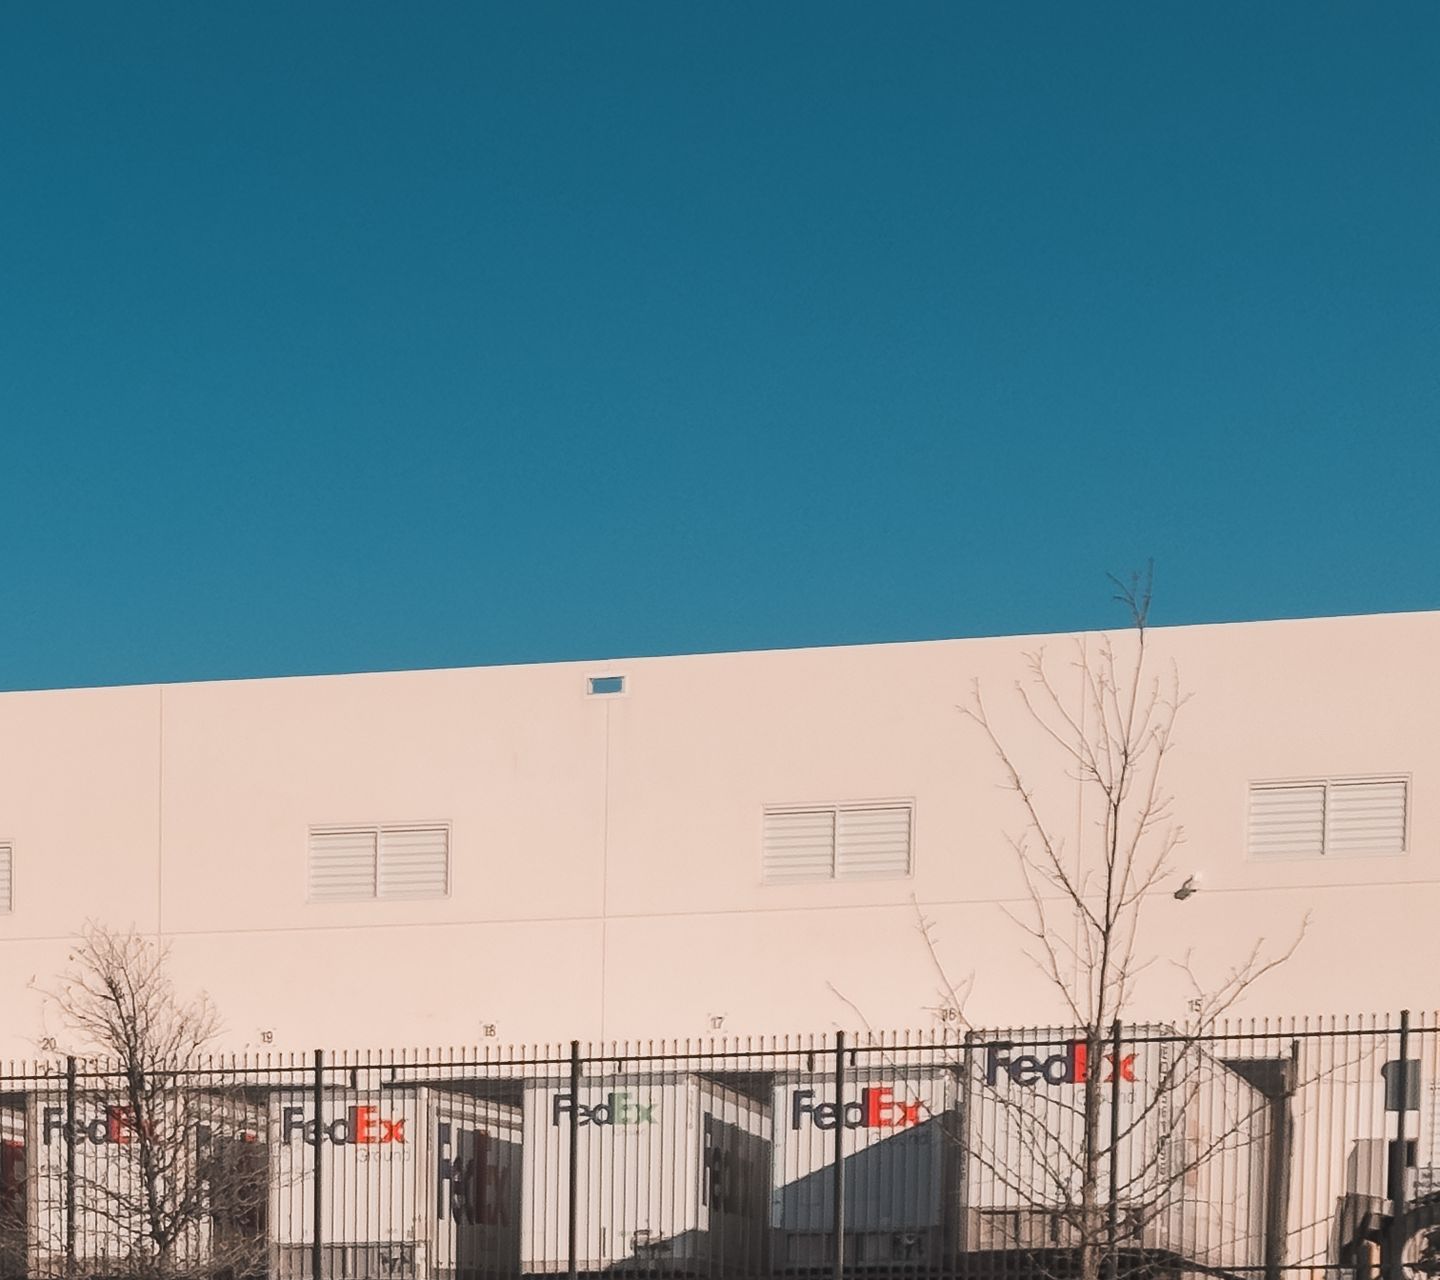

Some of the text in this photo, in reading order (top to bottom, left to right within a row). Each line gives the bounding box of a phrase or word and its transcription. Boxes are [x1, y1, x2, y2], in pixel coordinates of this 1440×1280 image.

[42, 1037, 57, 1050] 20
[283, 1105, 406, 1145] FedEx
[553, 1092, 657, 1126] FedEx
[792, 1087, 923, 1130] FedEx
